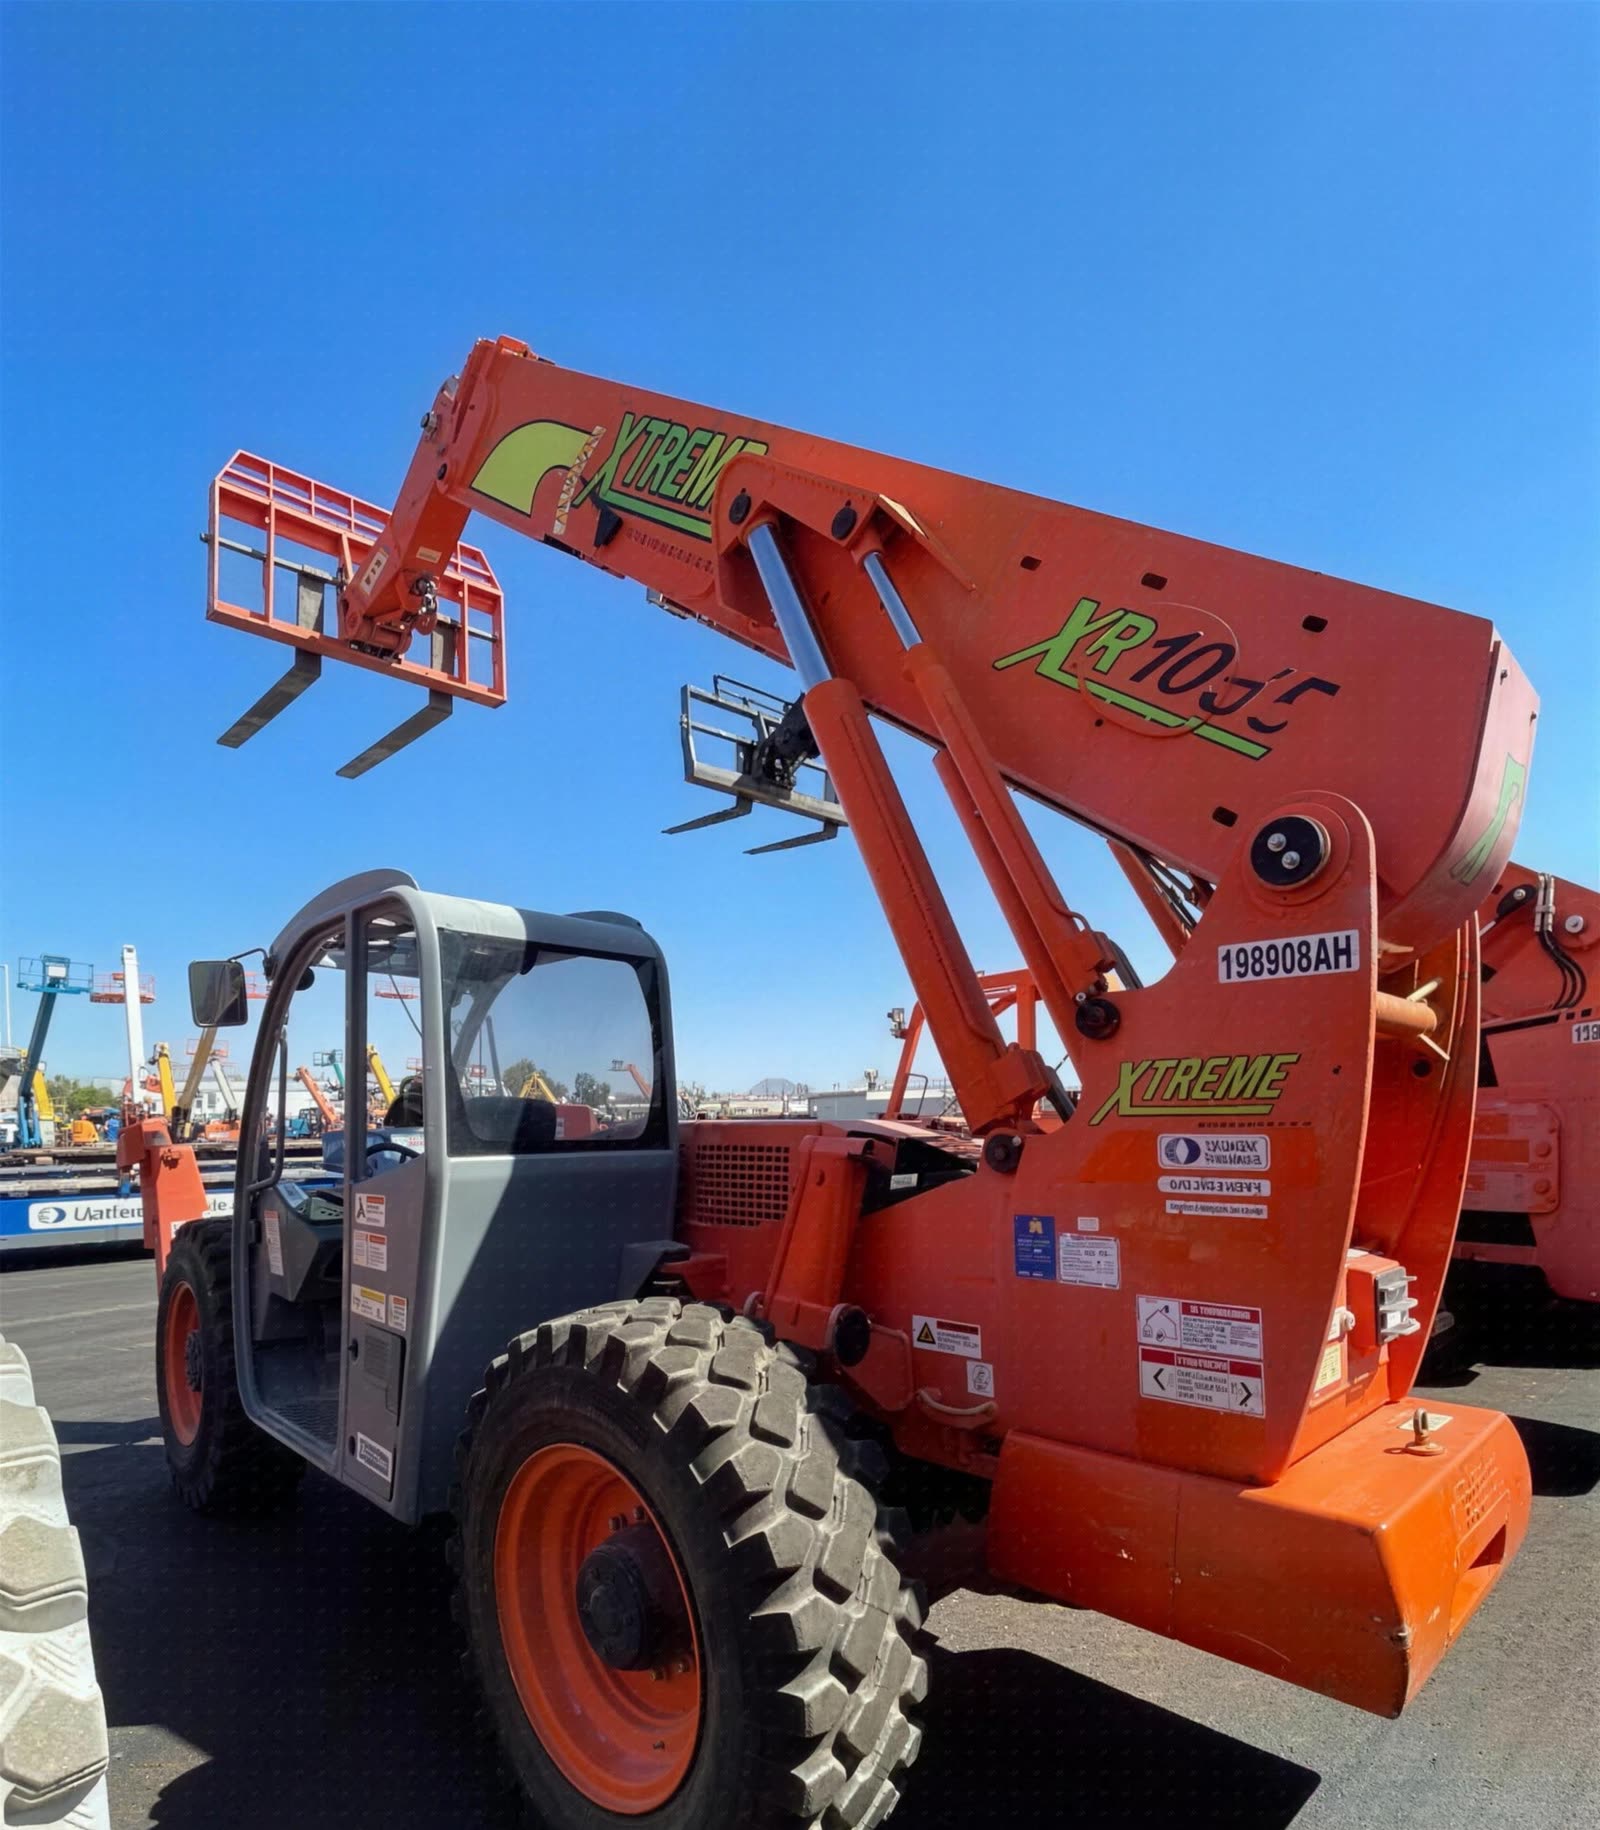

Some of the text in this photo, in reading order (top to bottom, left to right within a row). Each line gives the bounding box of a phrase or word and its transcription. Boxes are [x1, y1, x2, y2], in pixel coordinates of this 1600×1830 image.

[571, 411, 769, 512] XTREM
[1221, 934, 1352, 980] 198908AH
[1088, 1053, 1301, 1126] XTREME
